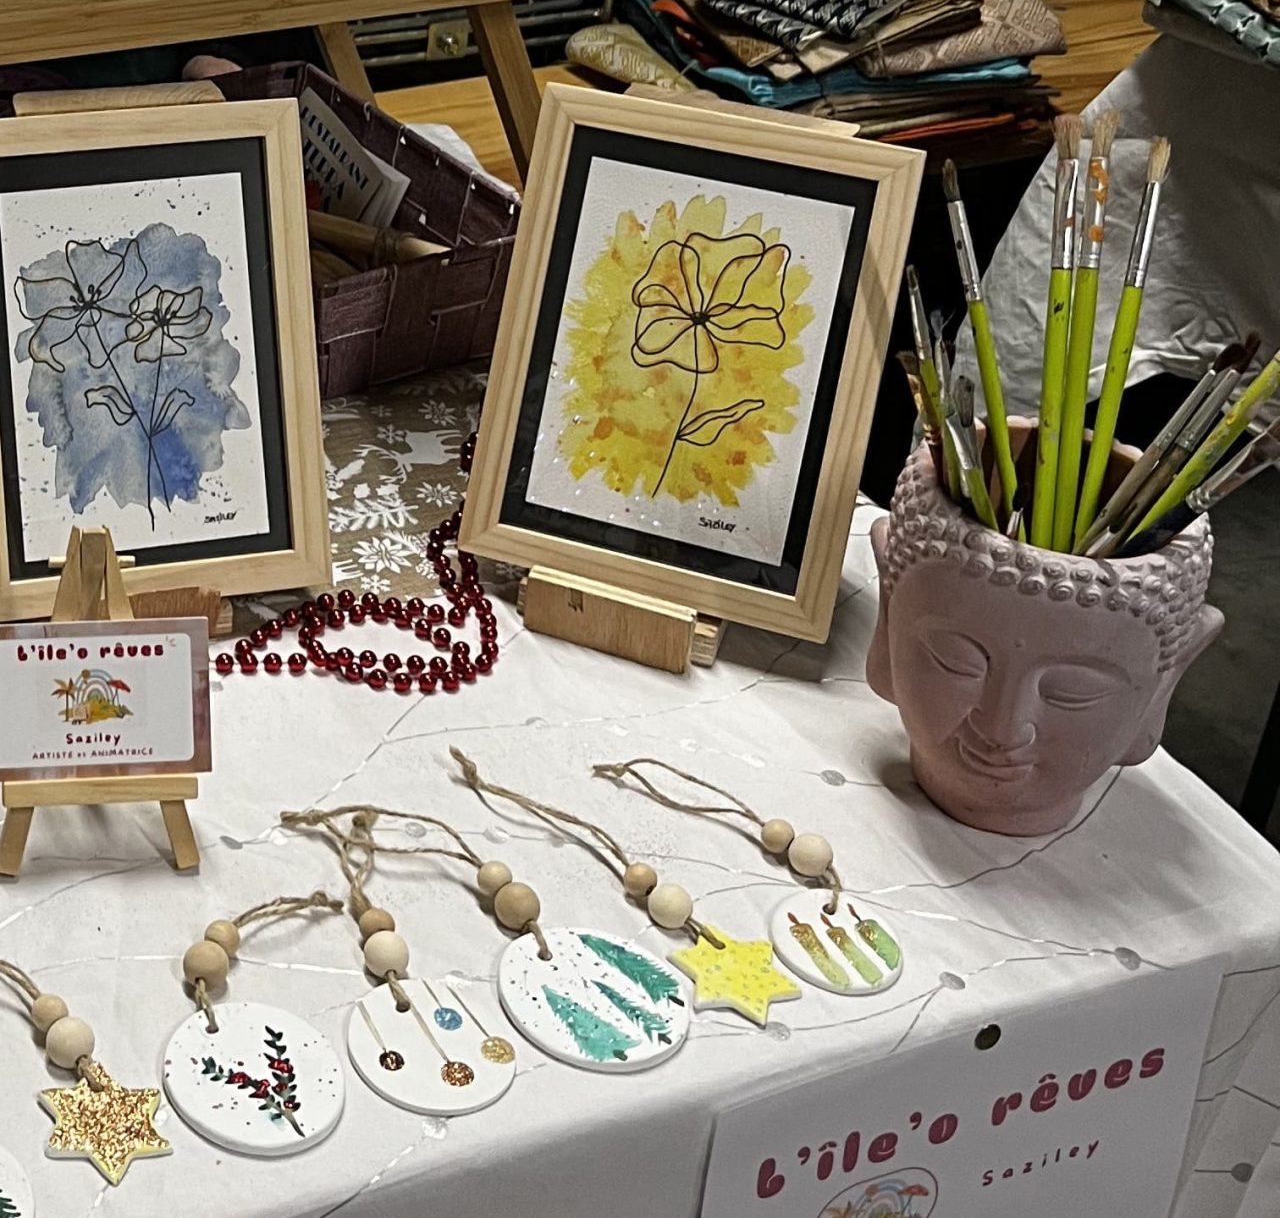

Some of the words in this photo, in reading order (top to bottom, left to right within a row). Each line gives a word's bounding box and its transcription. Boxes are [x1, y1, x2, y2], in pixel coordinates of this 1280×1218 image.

[100, 642, 164, 659] rêves
[65, 732, 122, 746] Saziley
[32, 751, 73, 761] ARTISTE
[91, 747, 153, 758] ANIMATRICE
[991, 1046, 1166, 1126] rêves
[981, 1138, 1102, 1188] Saziley
